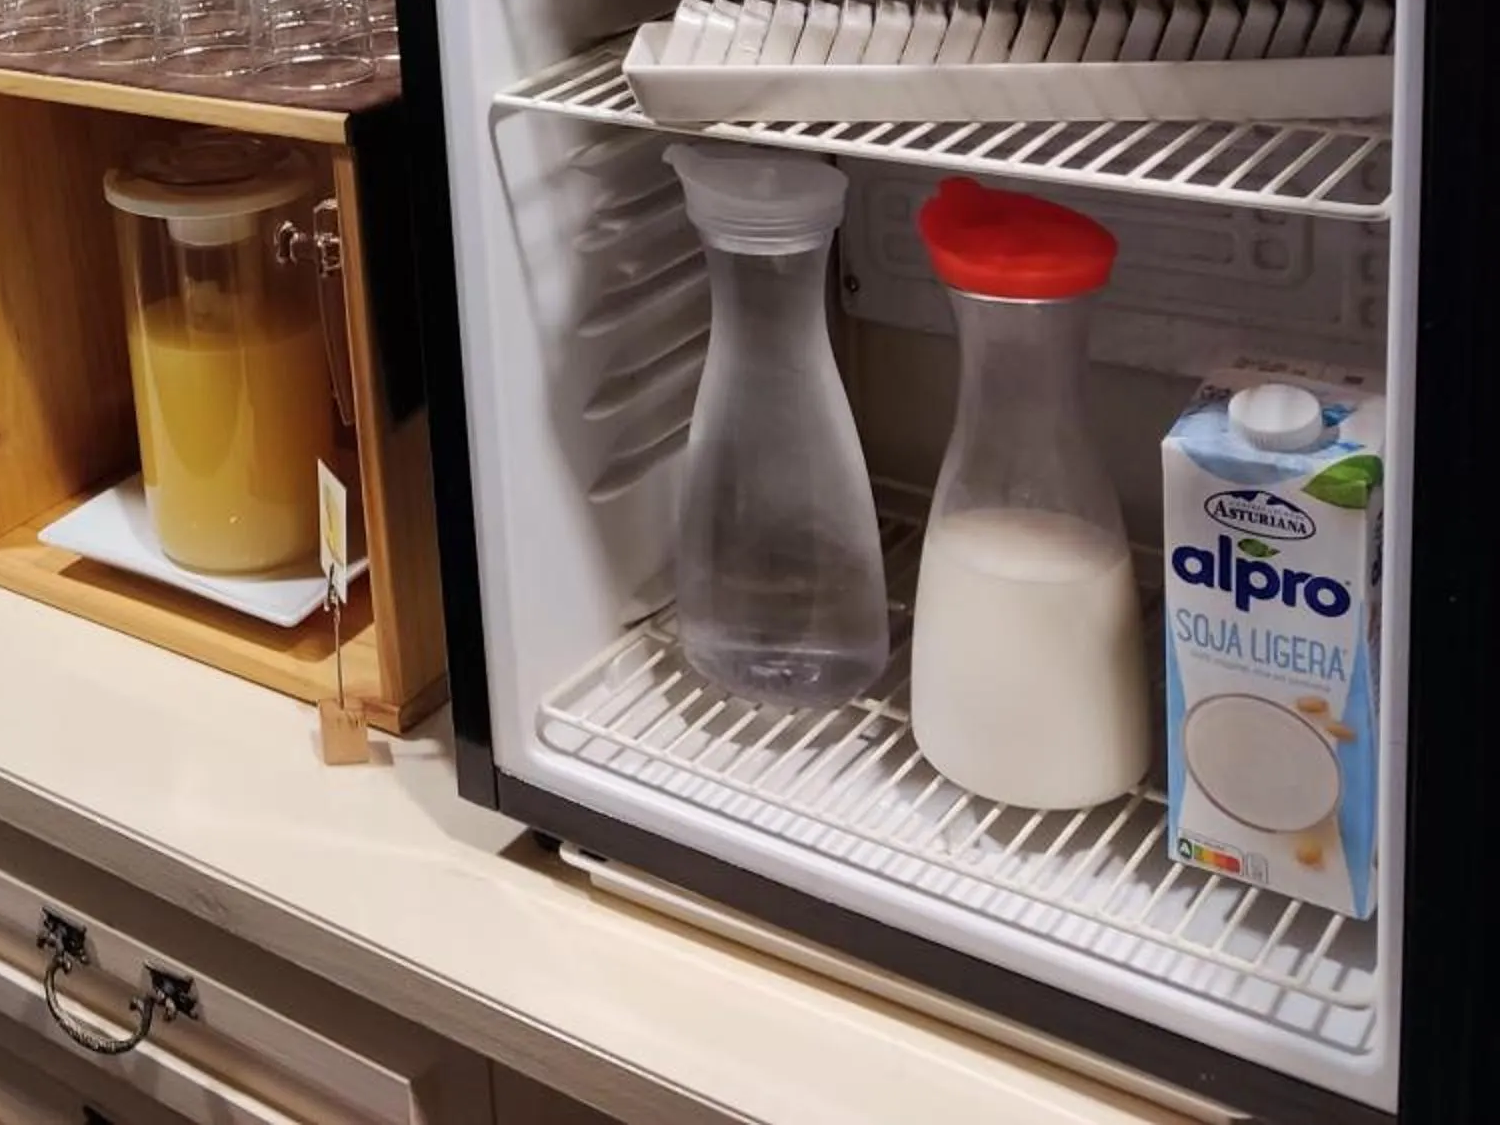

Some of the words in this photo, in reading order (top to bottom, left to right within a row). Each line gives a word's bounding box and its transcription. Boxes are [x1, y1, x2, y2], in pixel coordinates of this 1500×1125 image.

[1213, 500, 1307, 535] ASTURIANA
[1172, 533, 1352, 618] alpro
[1176, 608, 1243, 658] SOJA
[1251, 628, 1347, 682] LIGERA
